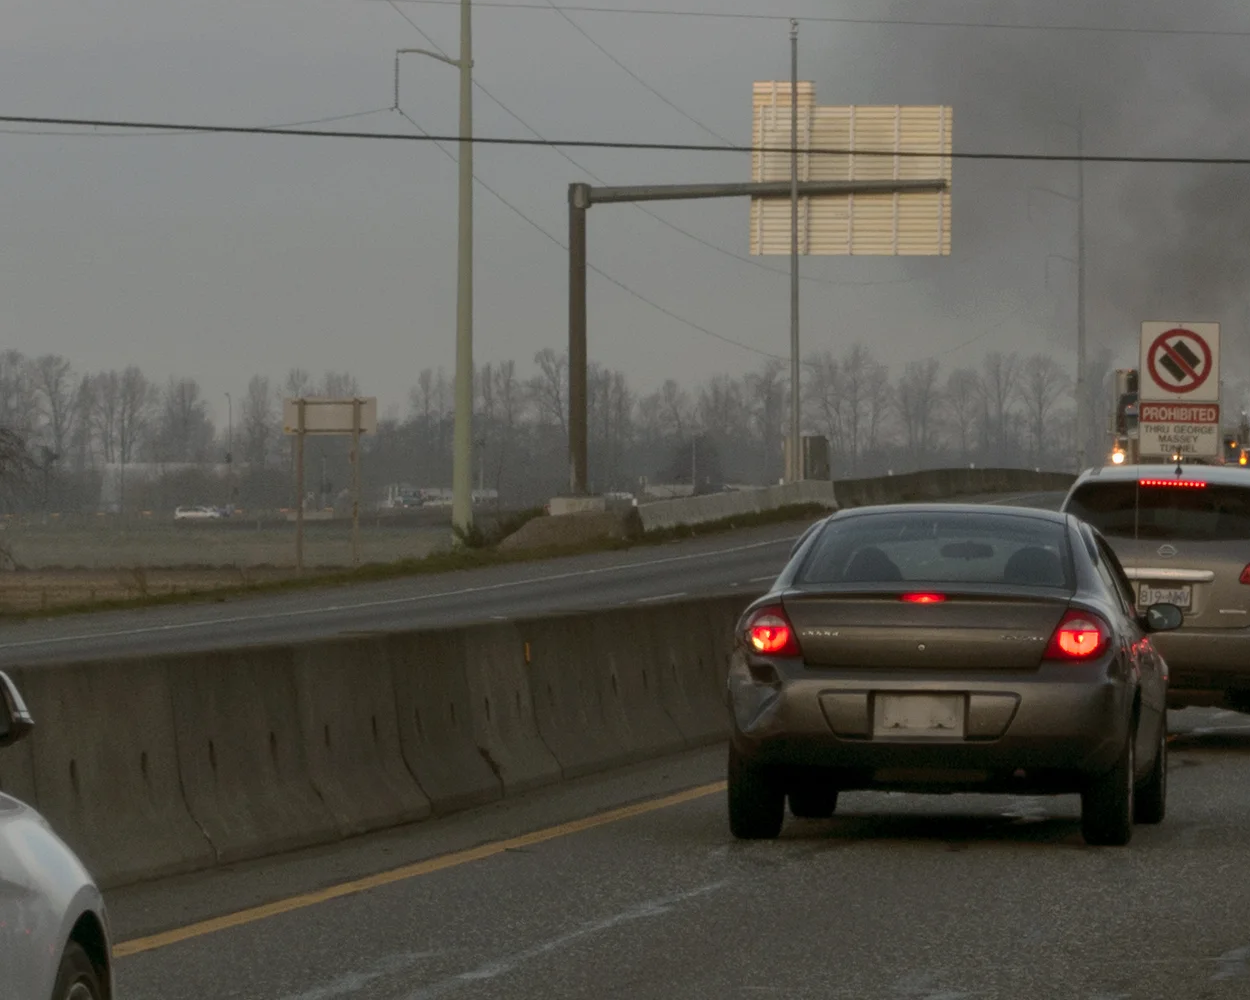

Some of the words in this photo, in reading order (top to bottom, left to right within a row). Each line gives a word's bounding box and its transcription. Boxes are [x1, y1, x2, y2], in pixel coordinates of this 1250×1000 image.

[1142, 407, 1217, 421] PROHIBITED
[1144, 425, 1170, 433] THRU
[1173, 425, 1214, 434] GEORGE
[1158, 435, 1199, 443] MASSEY
